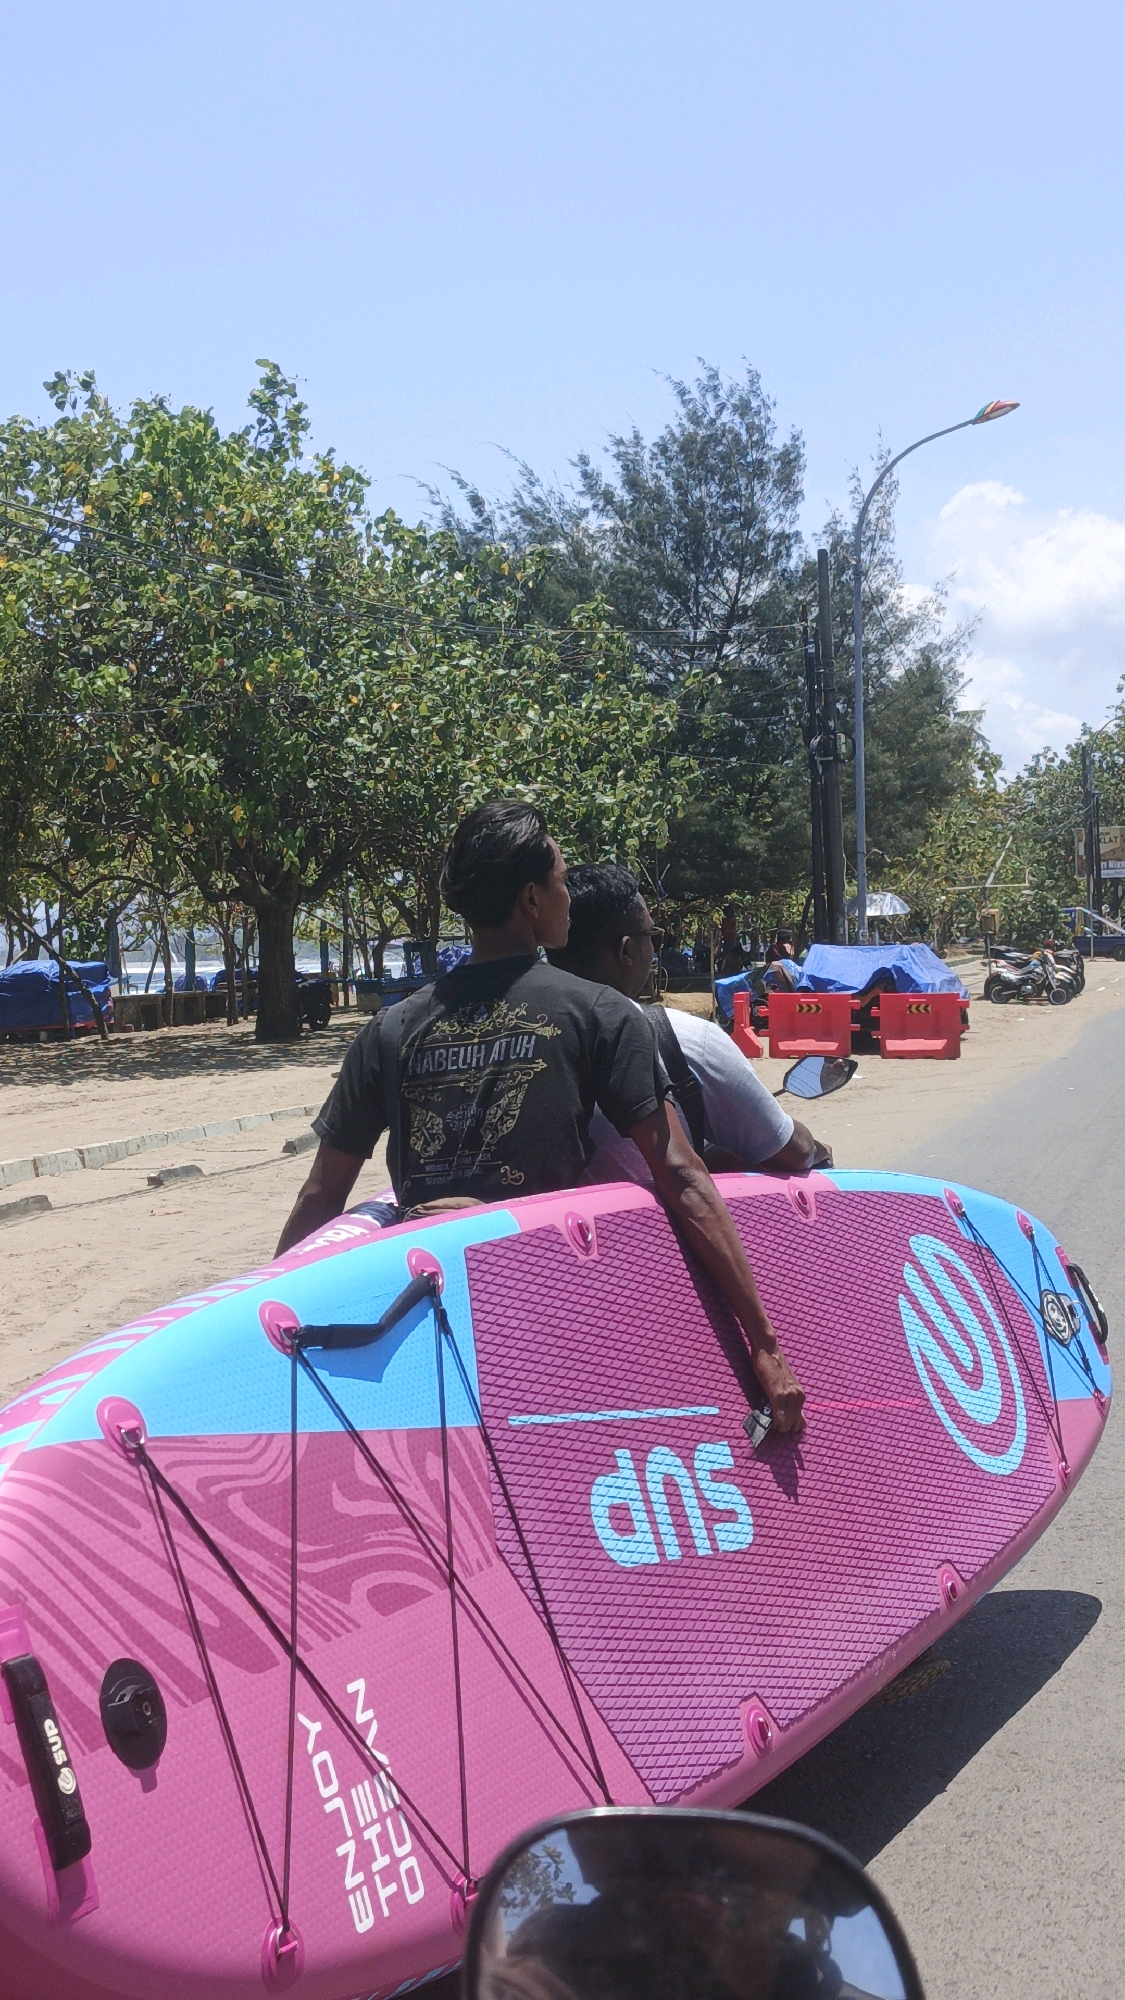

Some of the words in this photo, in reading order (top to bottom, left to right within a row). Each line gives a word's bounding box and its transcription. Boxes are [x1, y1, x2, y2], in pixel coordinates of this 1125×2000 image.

[489, 1034, 537, 1064] ATUH
[590, 1441, 754, 1568] SUP
[43, 1717, 68, 1766] SUP
[297, 1712, 375, 1934] ENJOY
[350, 1780, 398, 1917] THE
